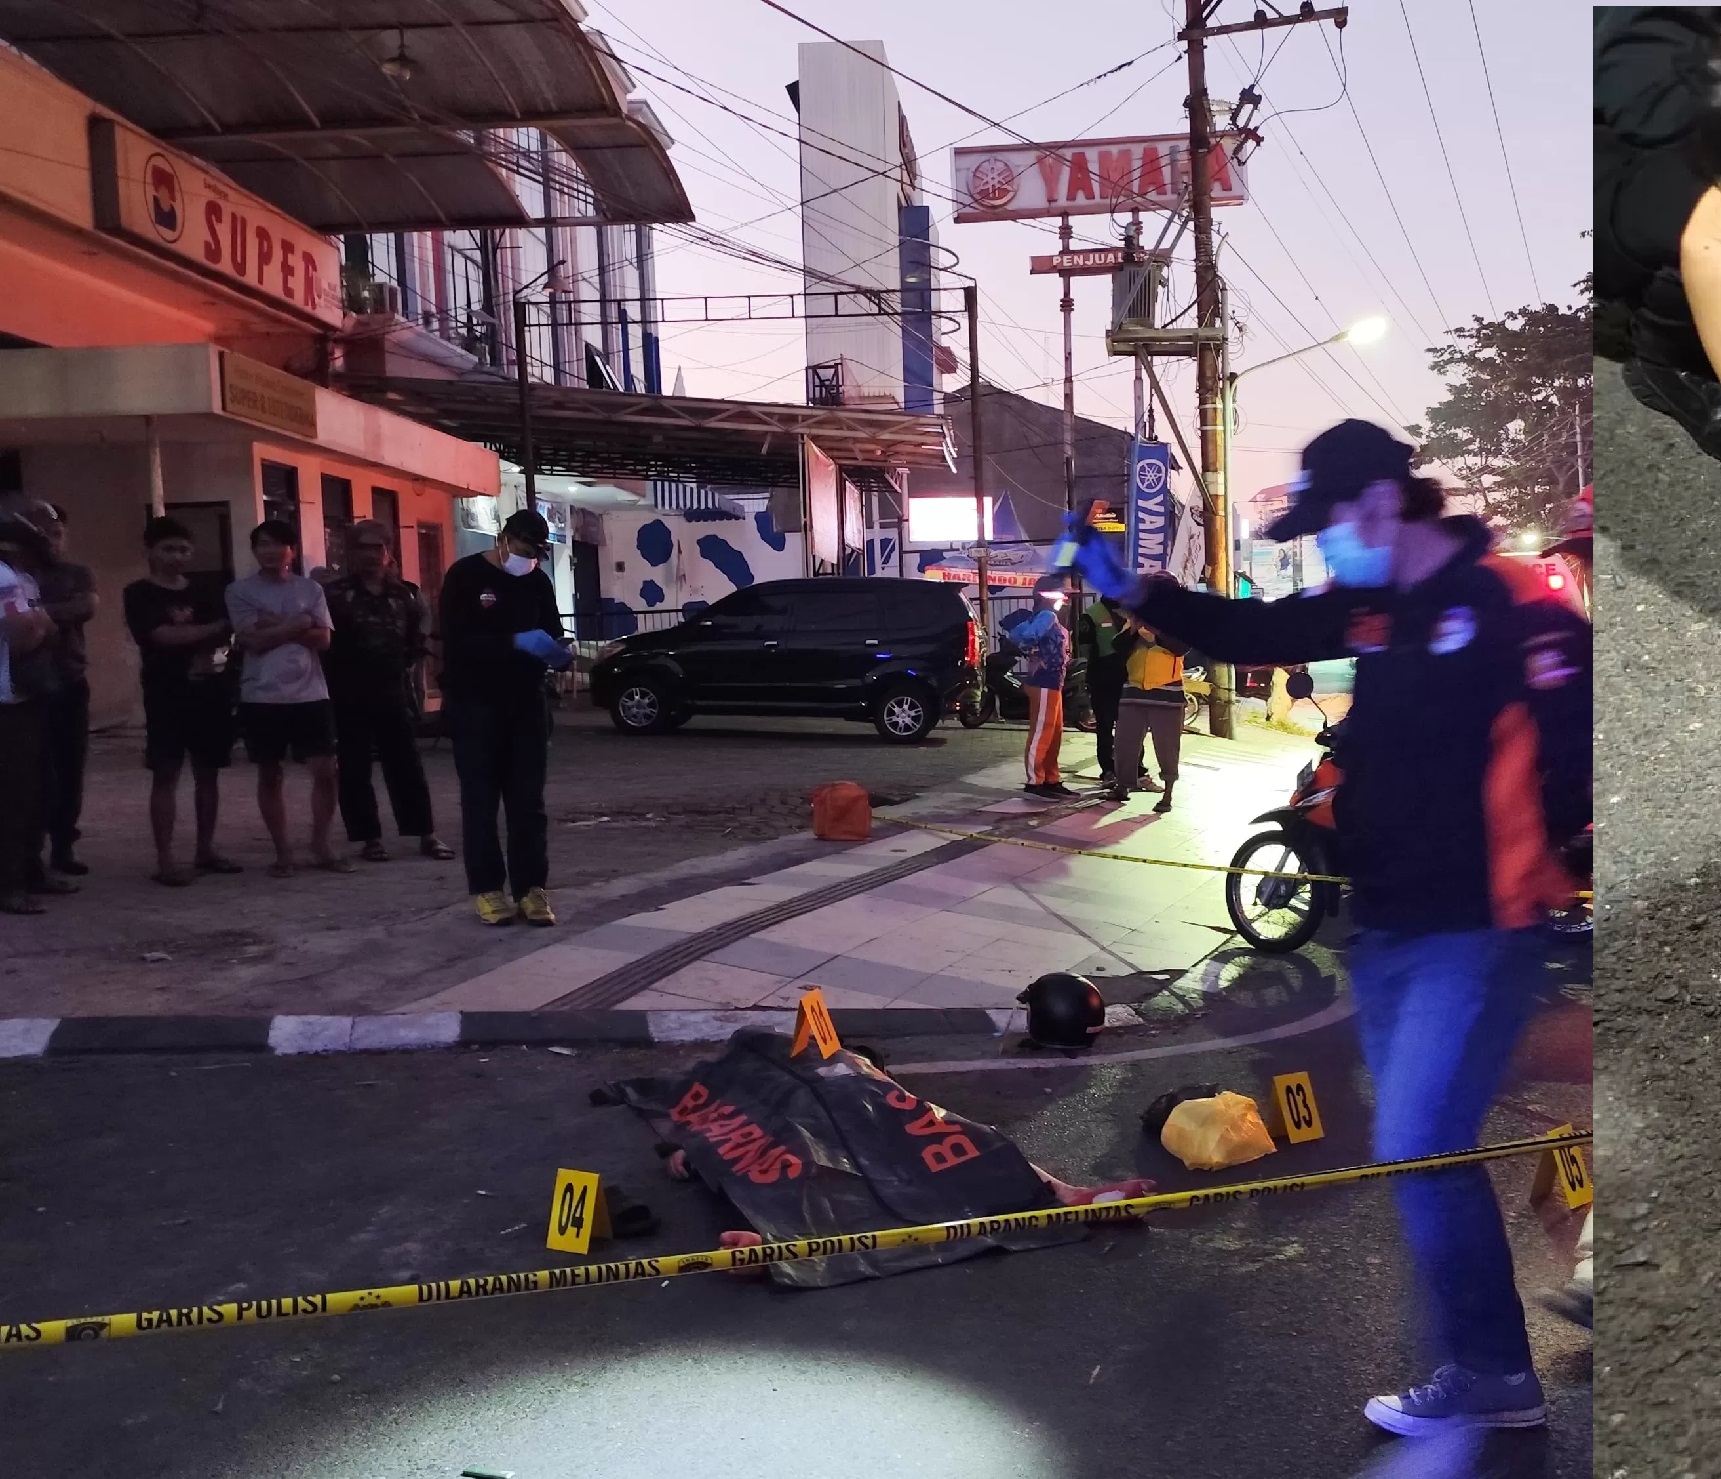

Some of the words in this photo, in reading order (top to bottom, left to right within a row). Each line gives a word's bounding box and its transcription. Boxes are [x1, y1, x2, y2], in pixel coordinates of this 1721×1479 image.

[1036, 142, 1233, 203] YAMAHA
[203, 200, 318, 310] SUPER
[1052, 251, 1149, 267] PENJUAL
[811, 1002, 833, 1046] 01
[1285, 1082, 1315, 1131] 03
[1558, 1146, 1584, 1193] 05
[556, 1181, 589, 1239] 04
[136, 1303, 225, 1332] GARIS
[236, 1294, 327, 1321] POLISI
[418, 1272, 538, 1302] DILARANG
[549, 1258, 660, 1289] MELINTAS
[731, 1242, 800, 1267] GARIS
[807, 1233, 878, 1258] POLISI
